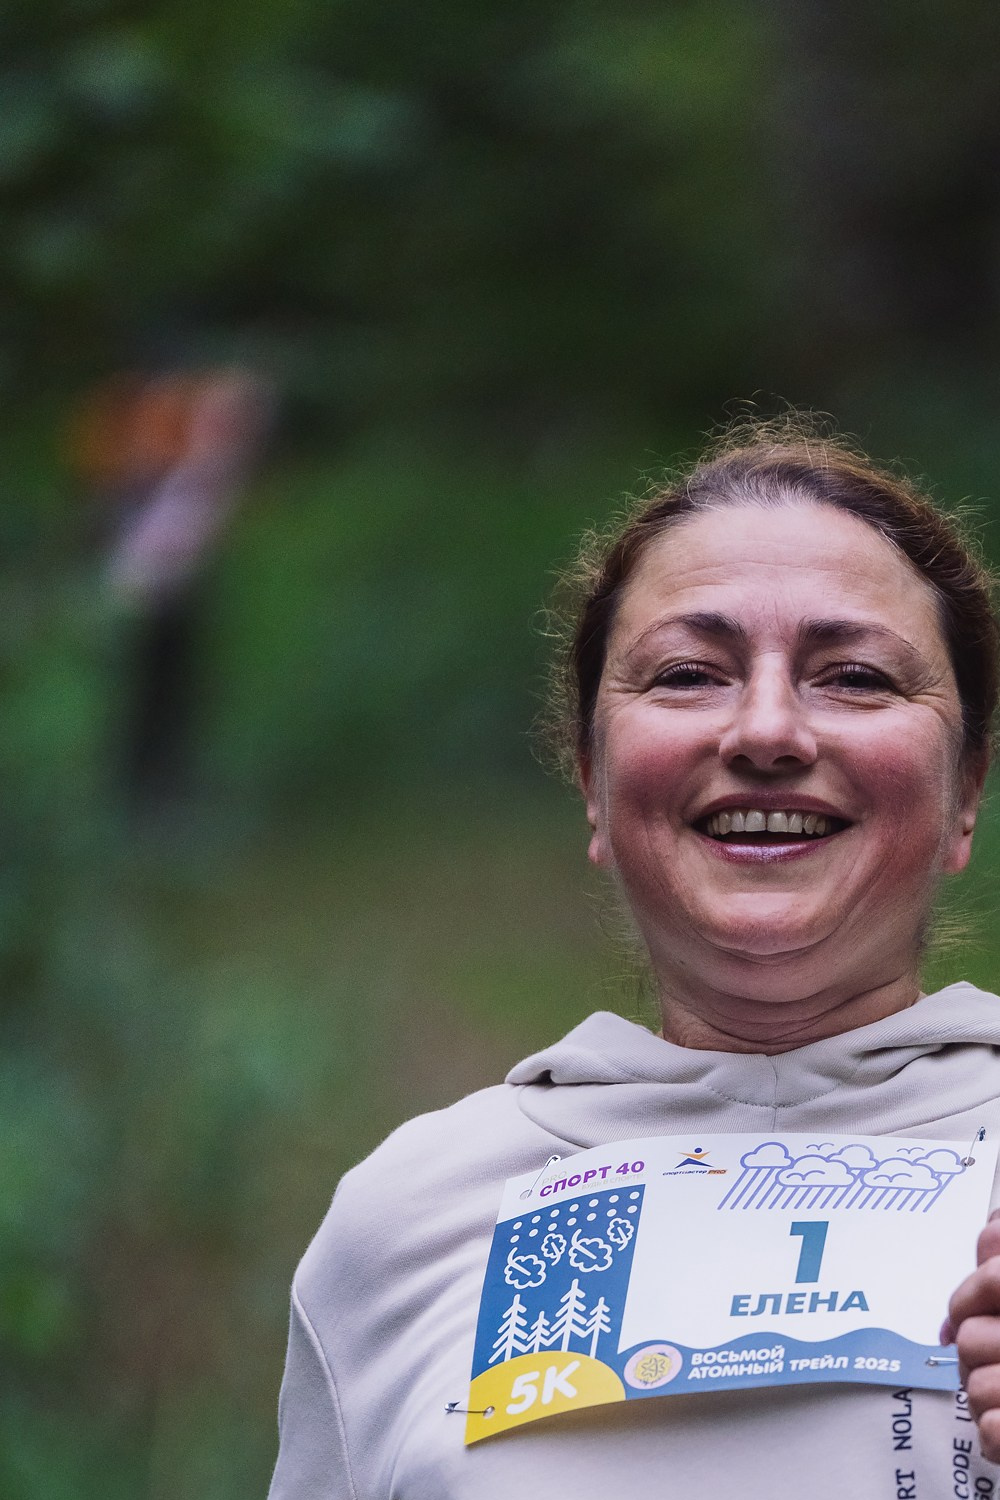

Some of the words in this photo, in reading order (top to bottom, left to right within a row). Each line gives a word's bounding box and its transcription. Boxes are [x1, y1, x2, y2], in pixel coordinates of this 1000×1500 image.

[539, 1165, 612, 1197] СПОРТ
[615, 1160, 645, 1175] 40
[789, 1220, 830, 1284] 1
[729, 1290, 870, 1317] ЕЛЕНА
[687, 1358, 785, 1380] АТОМНЫЙ
[789, 1354, 849, 1372] ТРЕЙЛ
[853, 1356, 902, 1373] 2025
[691, 1344, 786, 1366] ВОСЬМОЙ
[892, 1387, 913, 1452] NOLA
[955, 1384, 973, 1422] US
